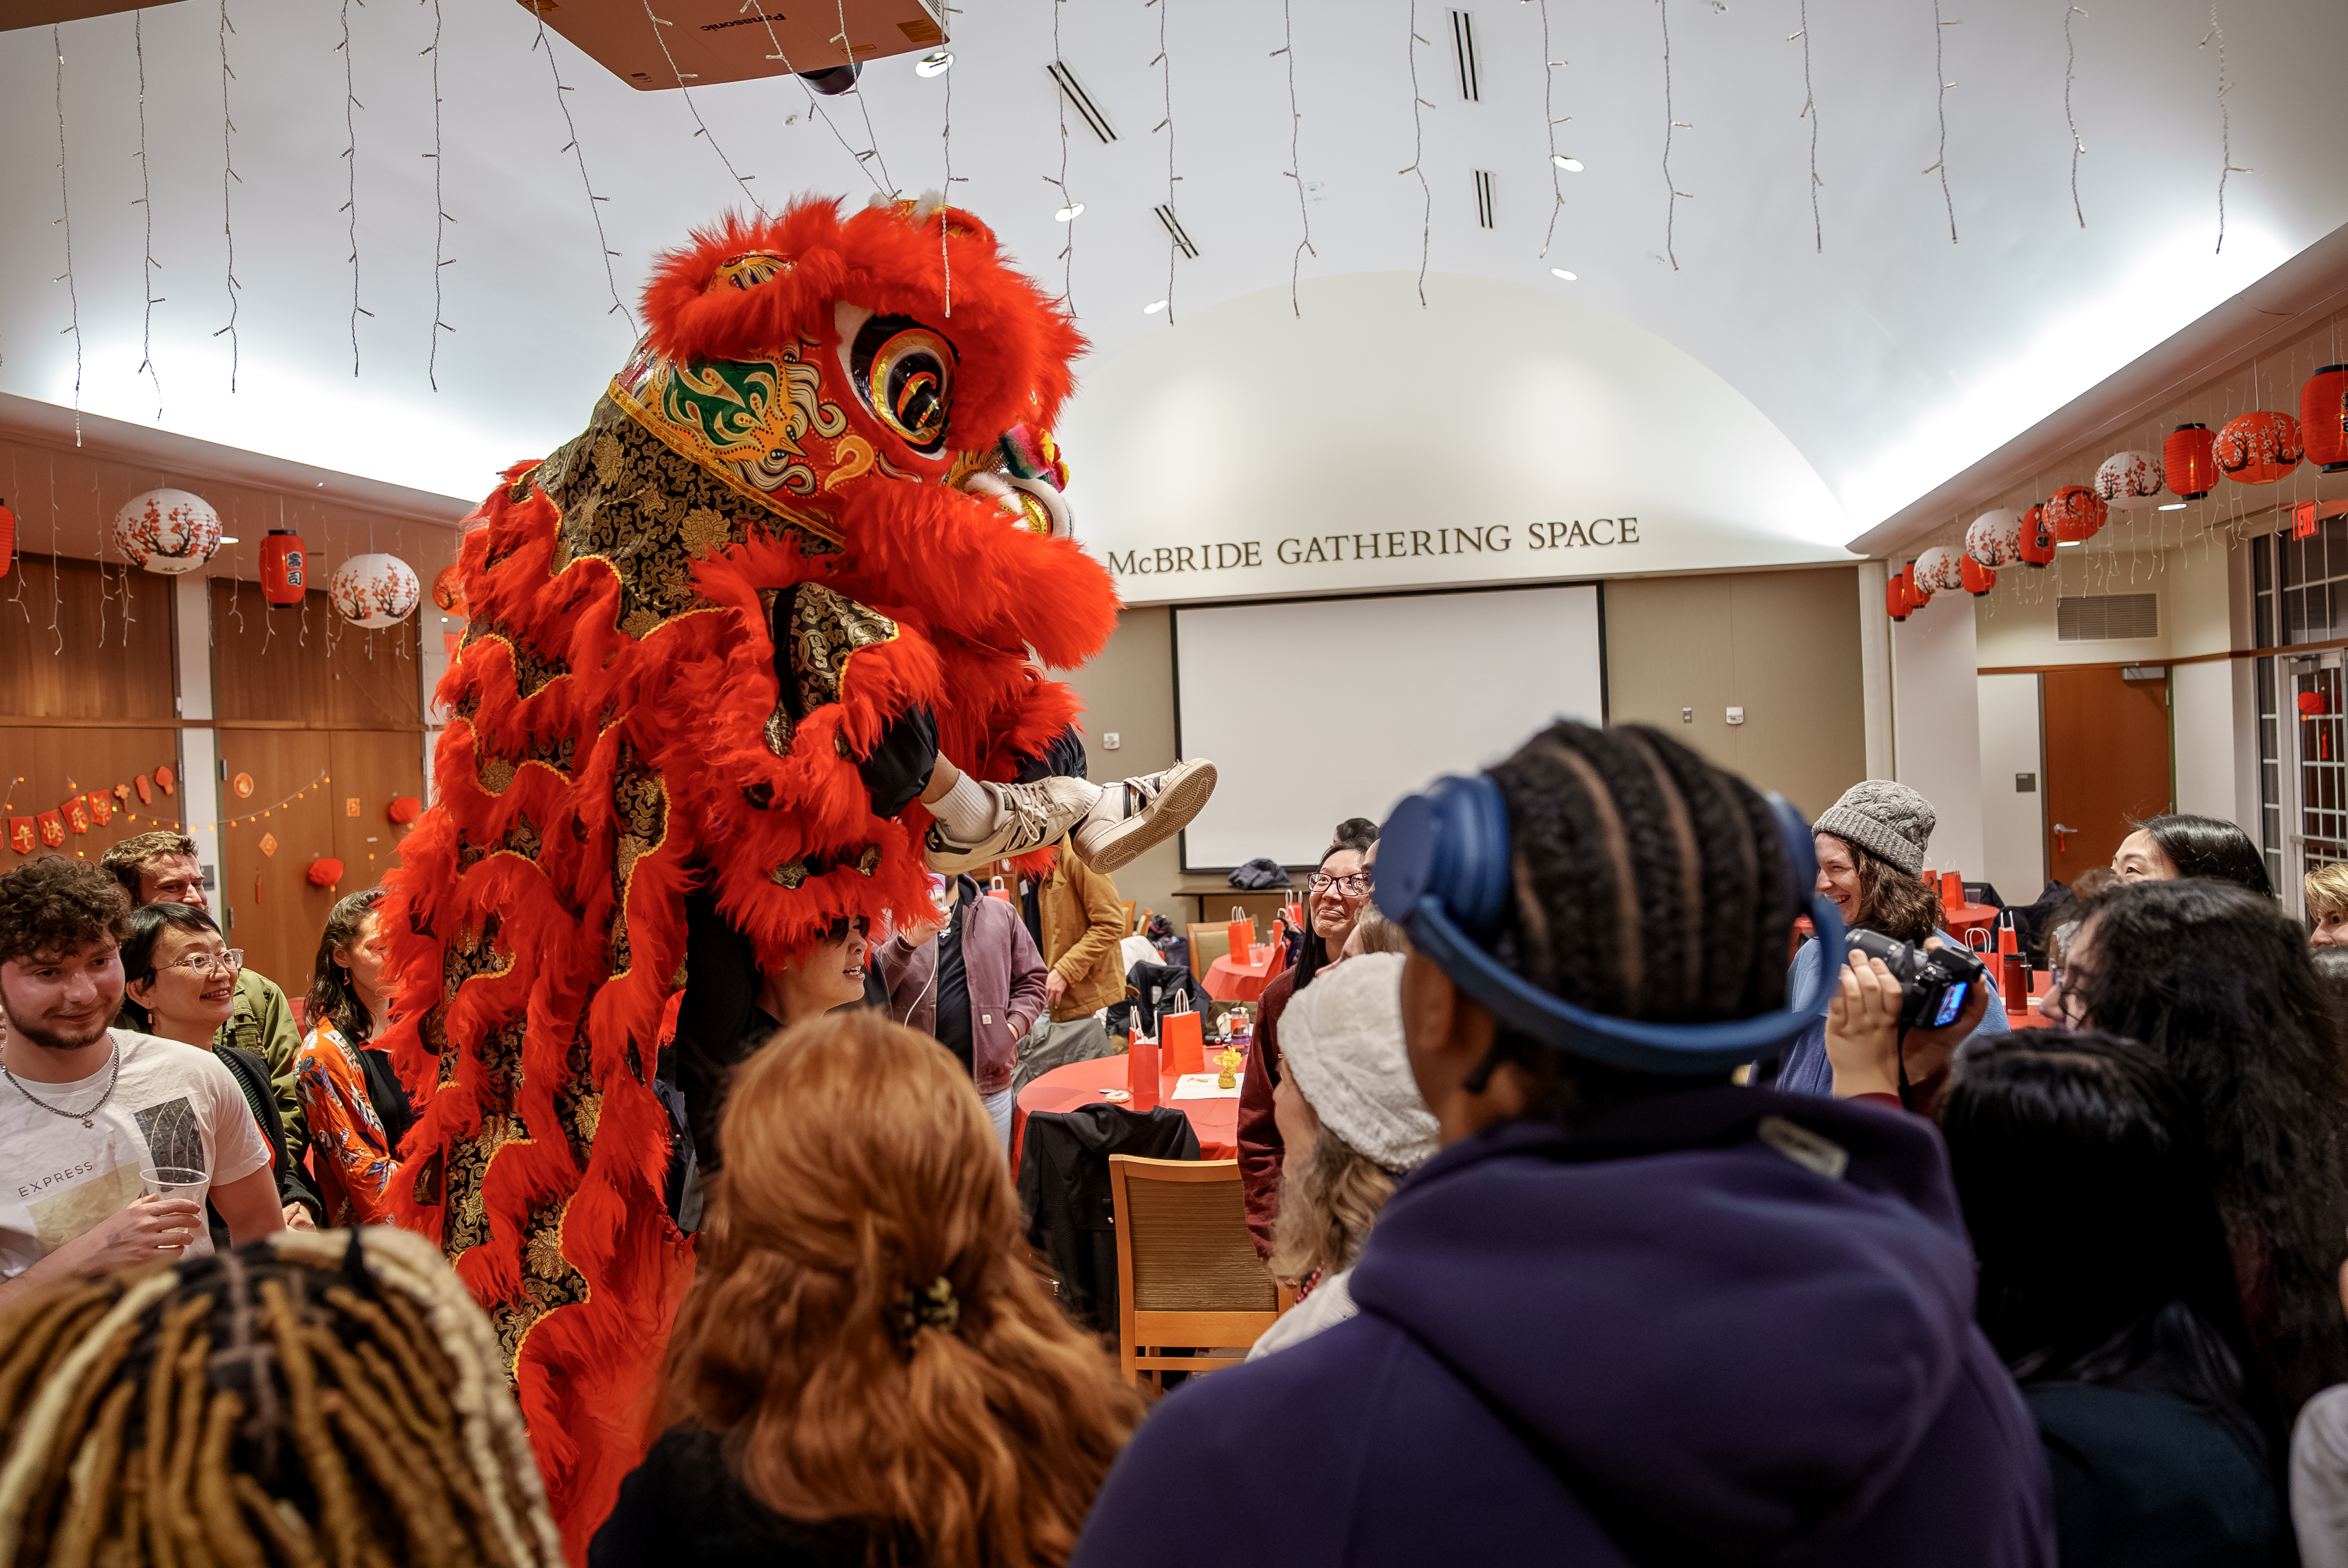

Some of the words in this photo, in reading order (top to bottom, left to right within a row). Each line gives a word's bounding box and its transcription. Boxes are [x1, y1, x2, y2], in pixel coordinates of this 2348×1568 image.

[700, 13, 786, 32] Panasonic
[1108, 541, 1262, 575] McBRIDE
[1277, 524, 1512, 565] GATHERING
[1528, 517, 1640, 550] SPACE
[18, 1162, 93, 1197] EXPRESS
